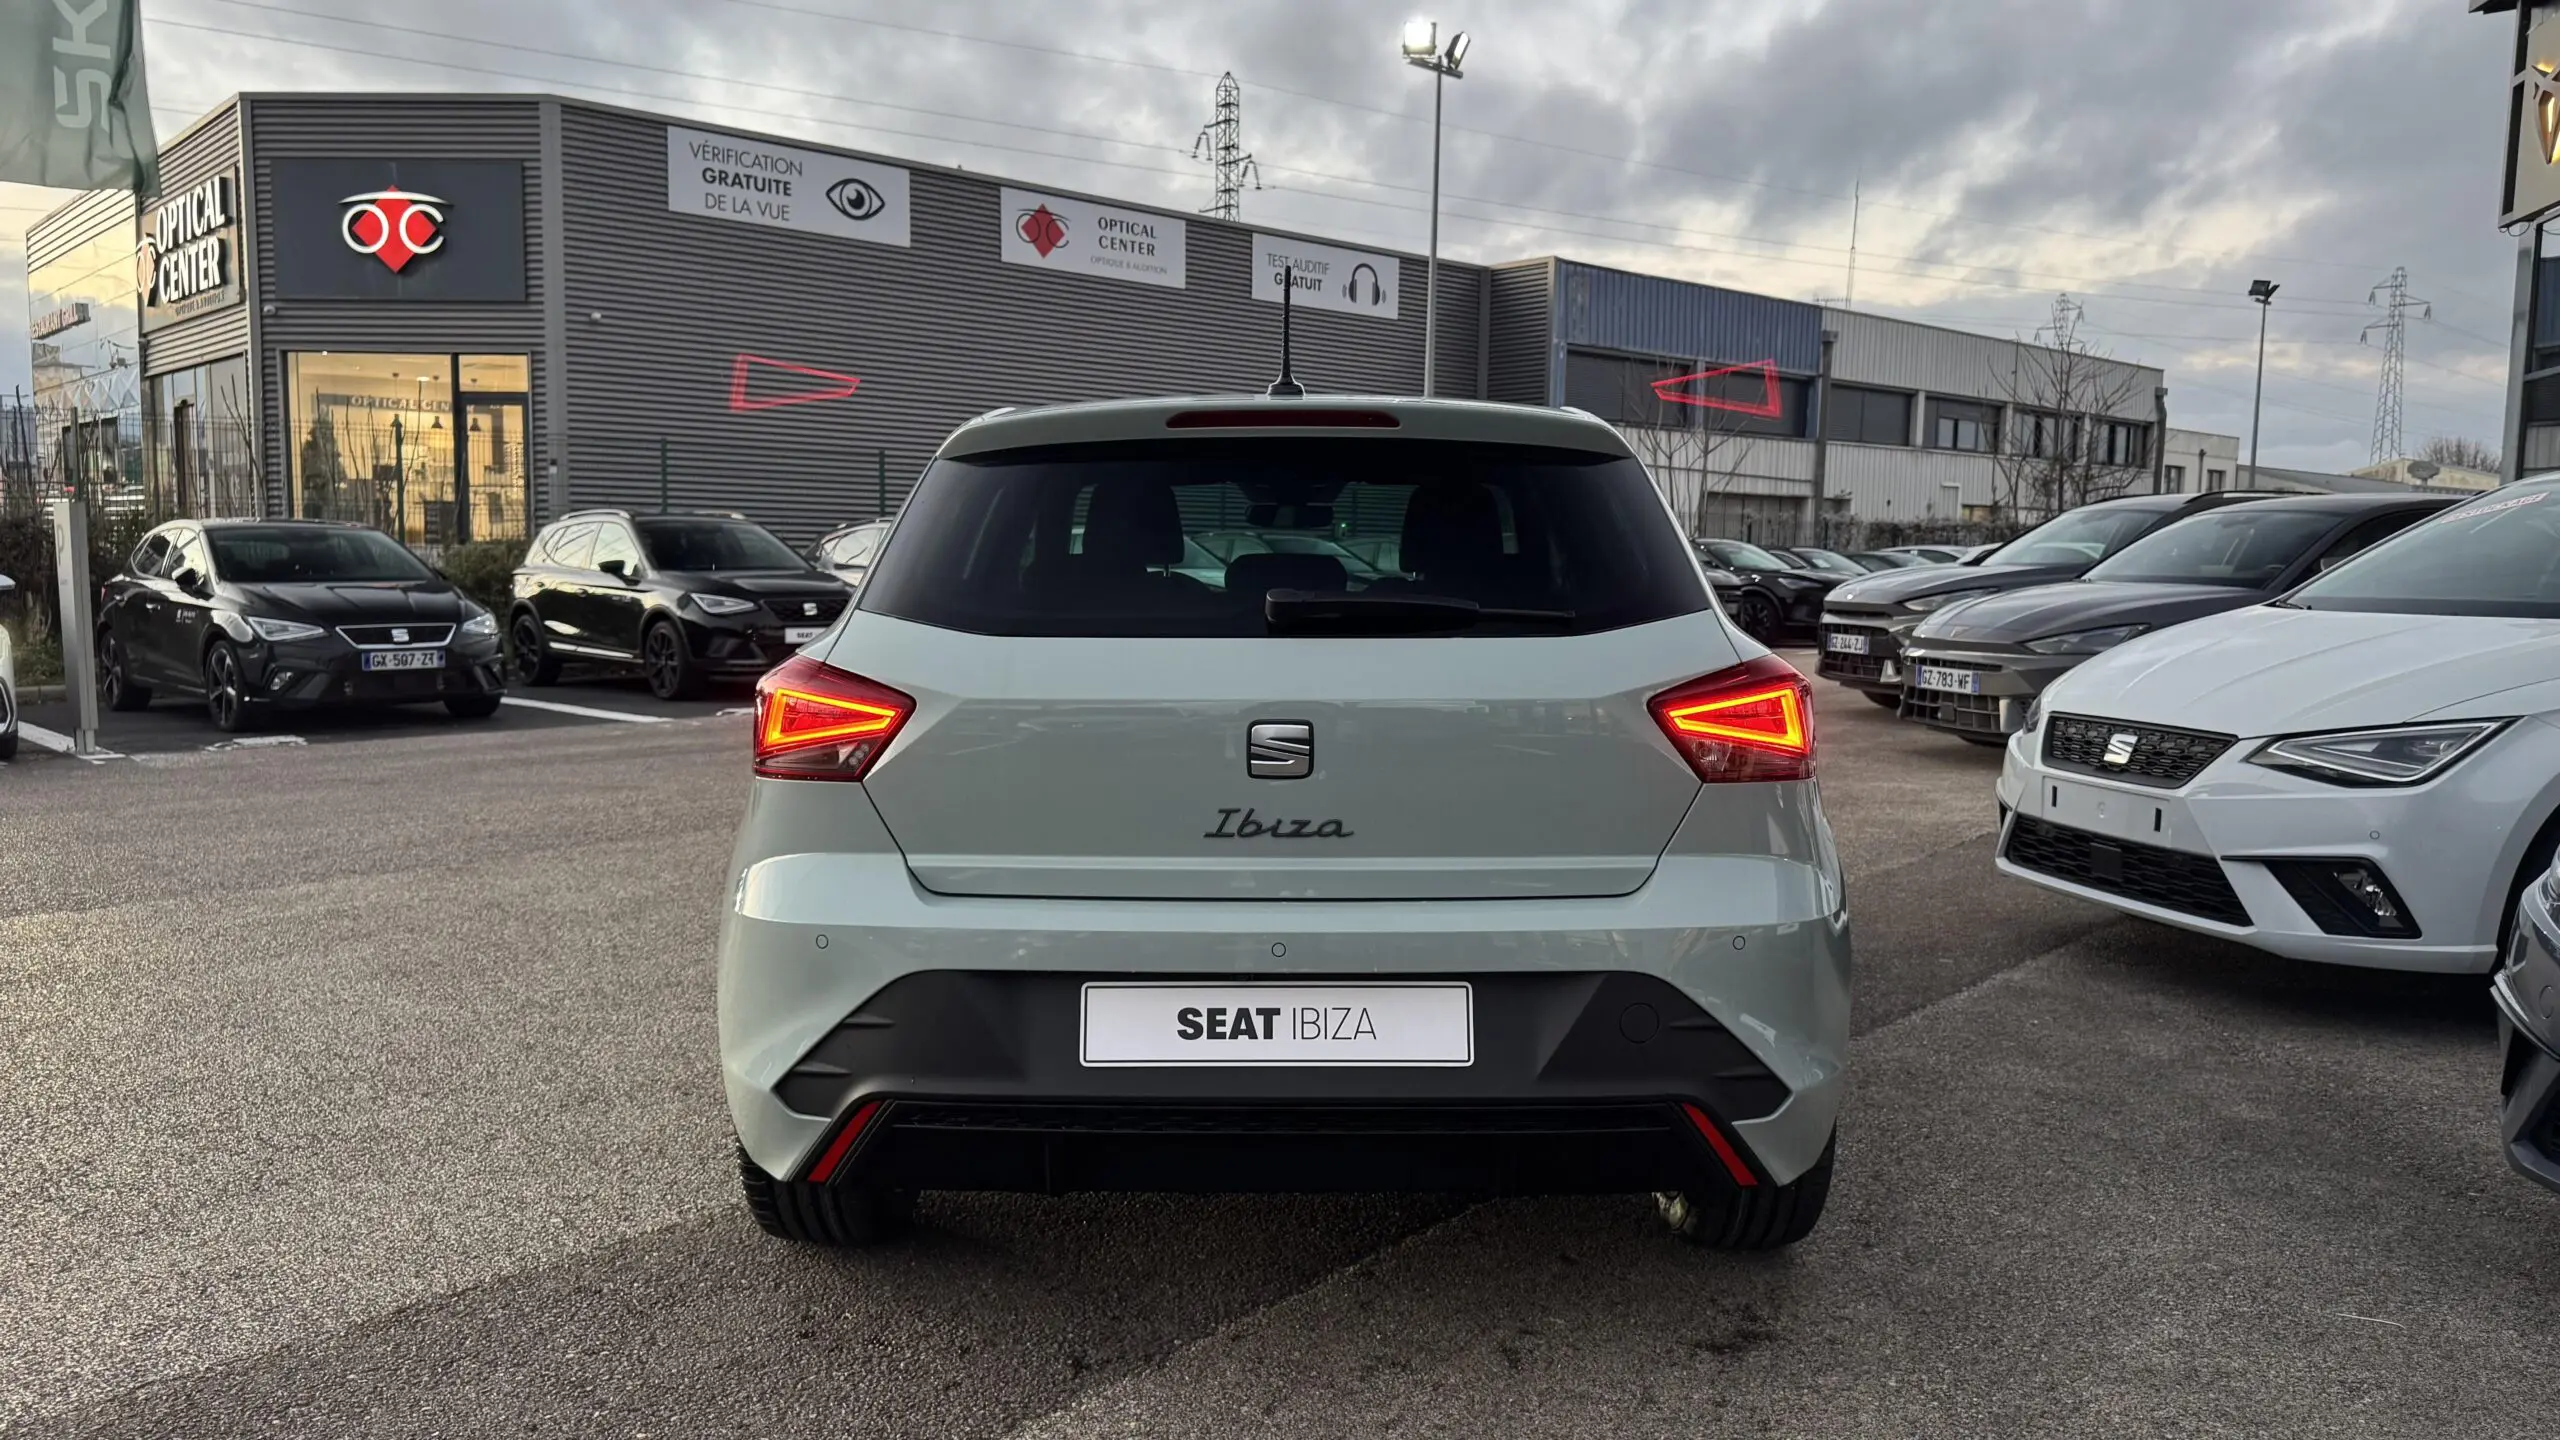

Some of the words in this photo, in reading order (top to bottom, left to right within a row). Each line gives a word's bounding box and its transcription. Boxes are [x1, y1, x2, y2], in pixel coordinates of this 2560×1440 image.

[689, 140, 803, 177] VÉRIFICATION
[702, 167, 793, 197] GRATUITE
[156, 175, 225, 254] OPTICAL
[705, 192, 728, 212] DE
[732, 196, 753, 216] LA
[757, 200, 791, 222] VUE
[1097, 216, 1157, 240] OPTICAL
[1098, 235, 1156, 257] CENTER
[159, 236, 220, 304] CENTER
[1266, 253, 1289, 269] TEST
[1292, 257, 1330, 276] AUDITIF
[1274, 271, 1323, 292] GATUIT
[30, 311, 60, 339] ESTAURANT
[351, 396, 418, 410] OPTICAL
[1203, 808, 1355, 839] Ibiza
[1176, 1007, 1282, 1041] SEAT
[1292, 1007, 1378, 1041] IBIZA
